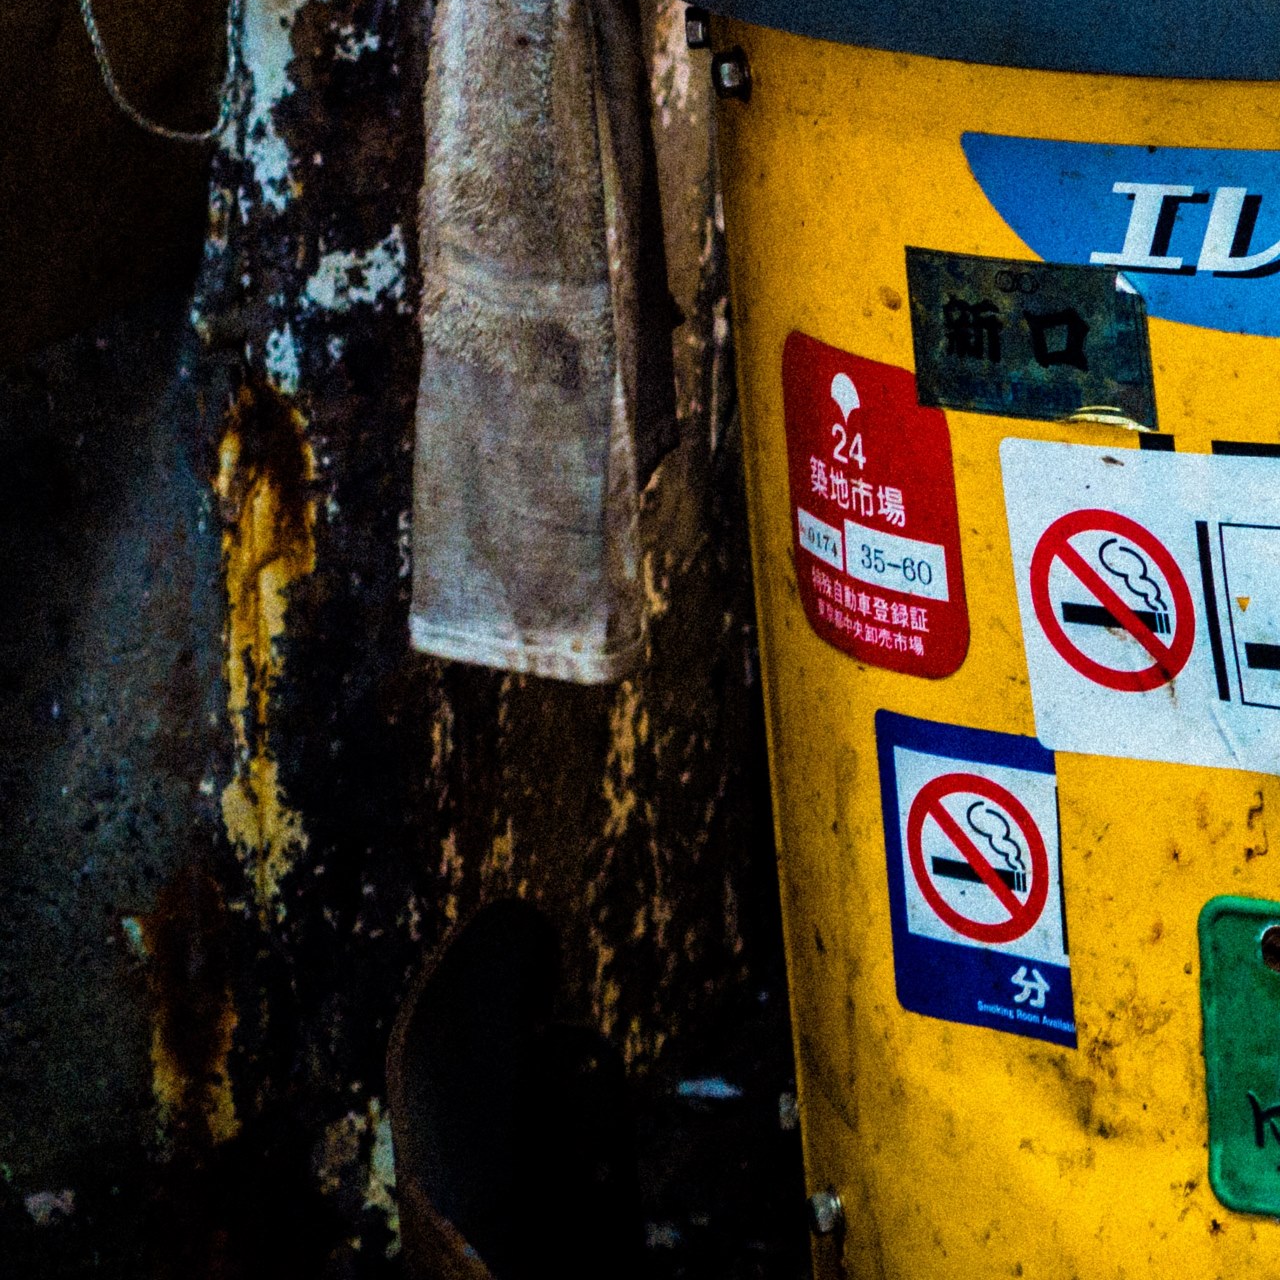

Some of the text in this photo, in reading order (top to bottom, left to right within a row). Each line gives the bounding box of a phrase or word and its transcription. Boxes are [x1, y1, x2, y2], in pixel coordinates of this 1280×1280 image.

[831, 423, 867, 470] 24
[810, 455, 906, 528] 築地市場
[860, 544, 933, 586] 35-60
[977, 1000, 1015, 1020] Smoking
[1016, 1008, 1041, 1024] Room
